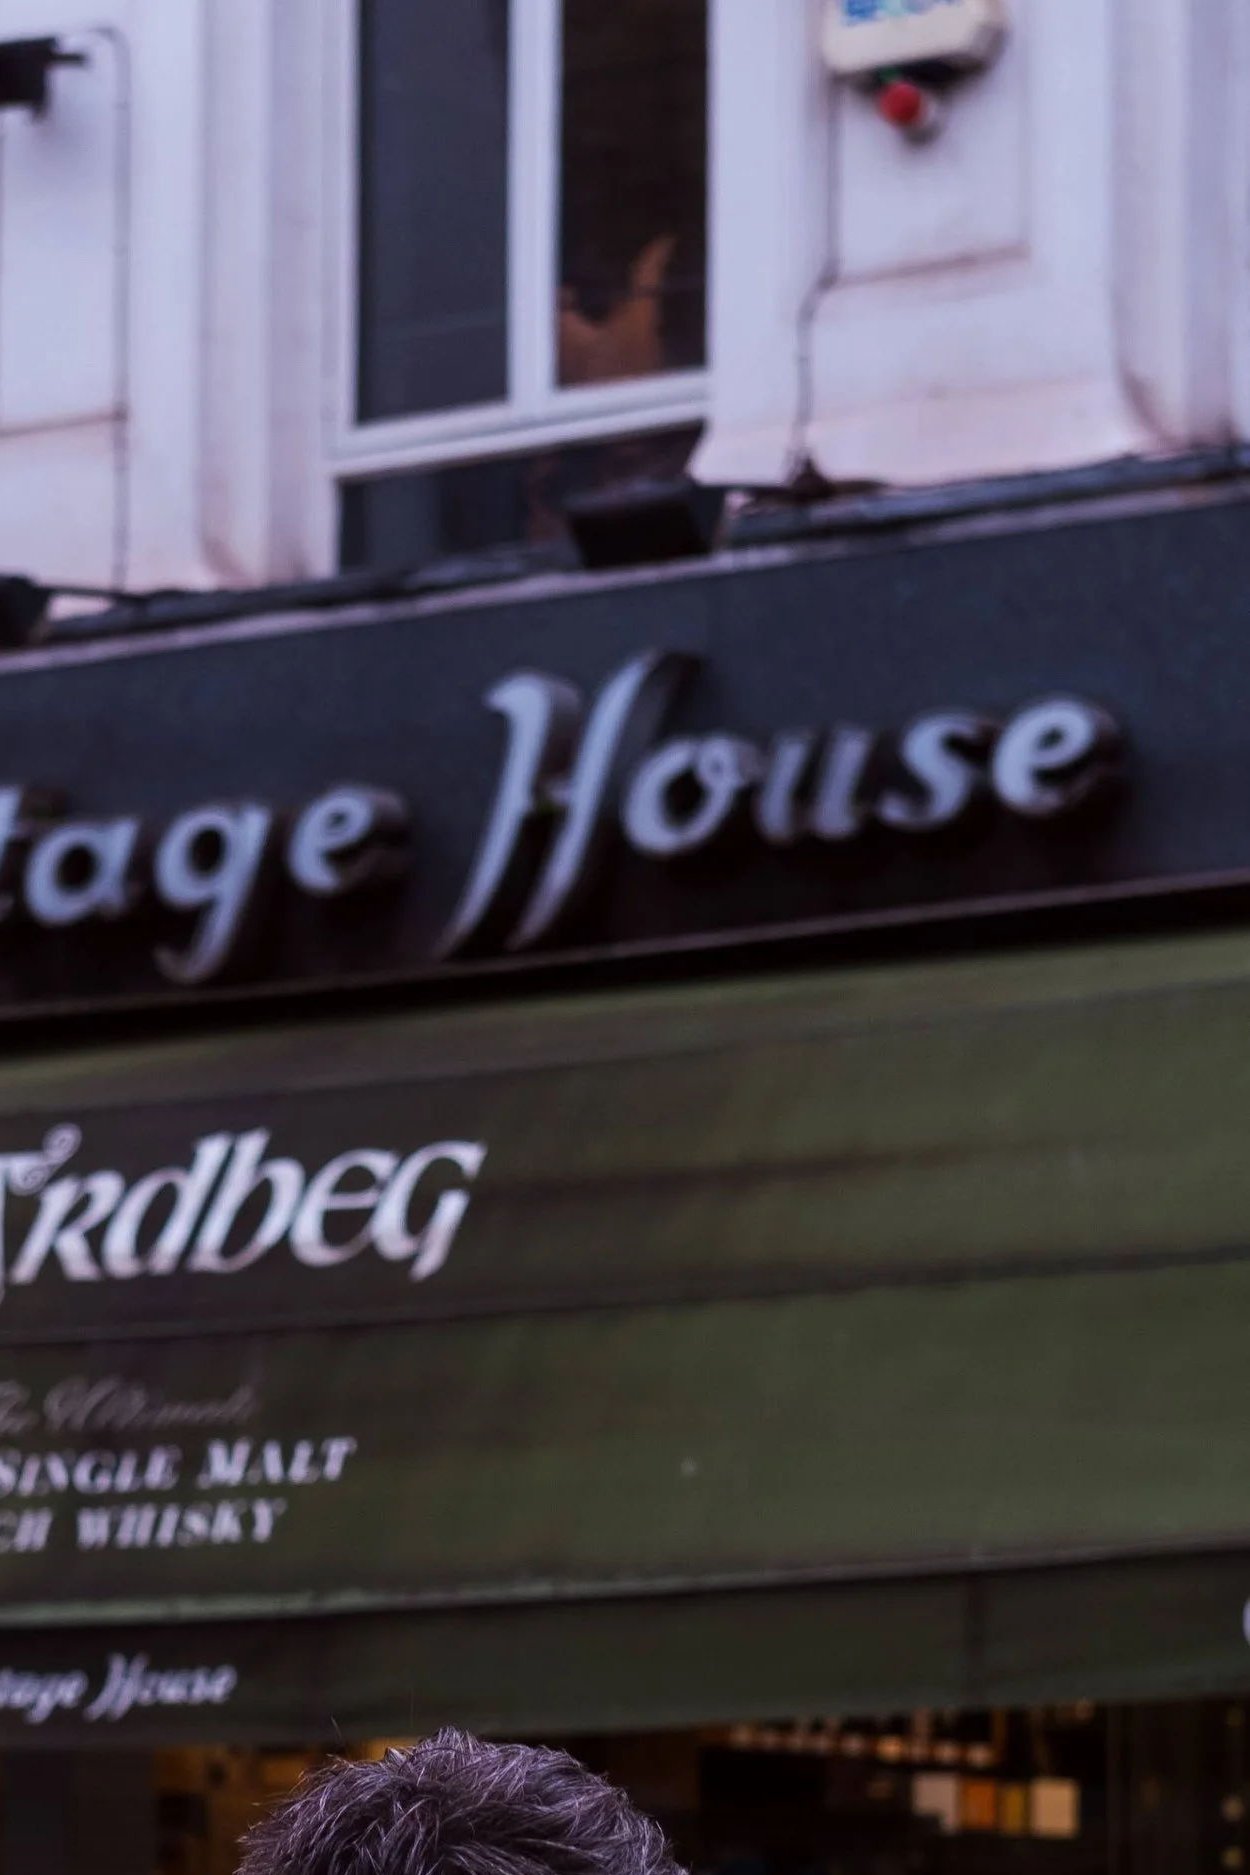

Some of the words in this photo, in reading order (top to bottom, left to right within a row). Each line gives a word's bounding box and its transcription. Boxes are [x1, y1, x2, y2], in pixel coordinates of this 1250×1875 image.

[435, 648, 1106, 958] House
[197, 1436, 357, 1491] MALT
[76, 1498, 287, 1550] WHISKY
